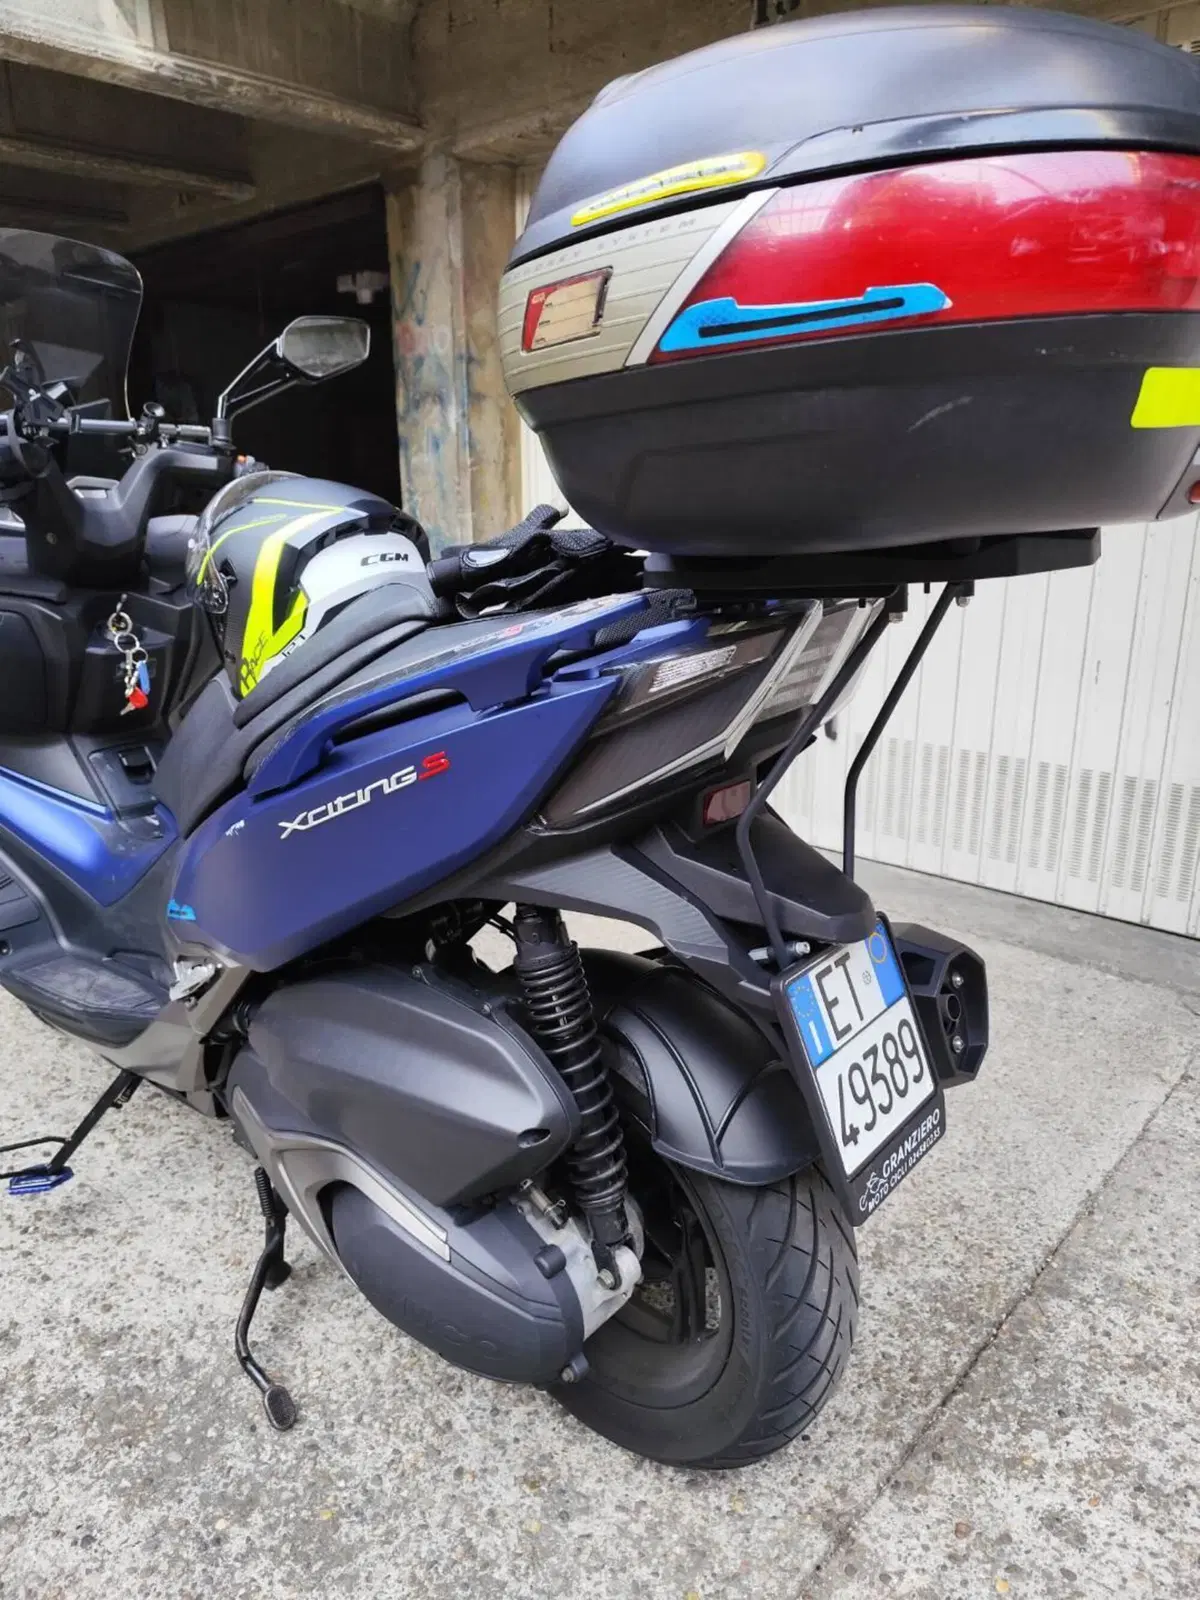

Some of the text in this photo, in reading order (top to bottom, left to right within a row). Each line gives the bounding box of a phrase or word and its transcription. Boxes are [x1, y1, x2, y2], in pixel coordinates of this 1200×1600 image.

[360, 552, 409, 567] CGM
[815, 952, 864, 1042] ET
[838, 1019, 923, 1148] 49389
[883, 1108, 940, 1178] GRANZIERO
[868, 1183, 889, 1212] MOTO
[890, 1161, 908, 1187] CICLI
